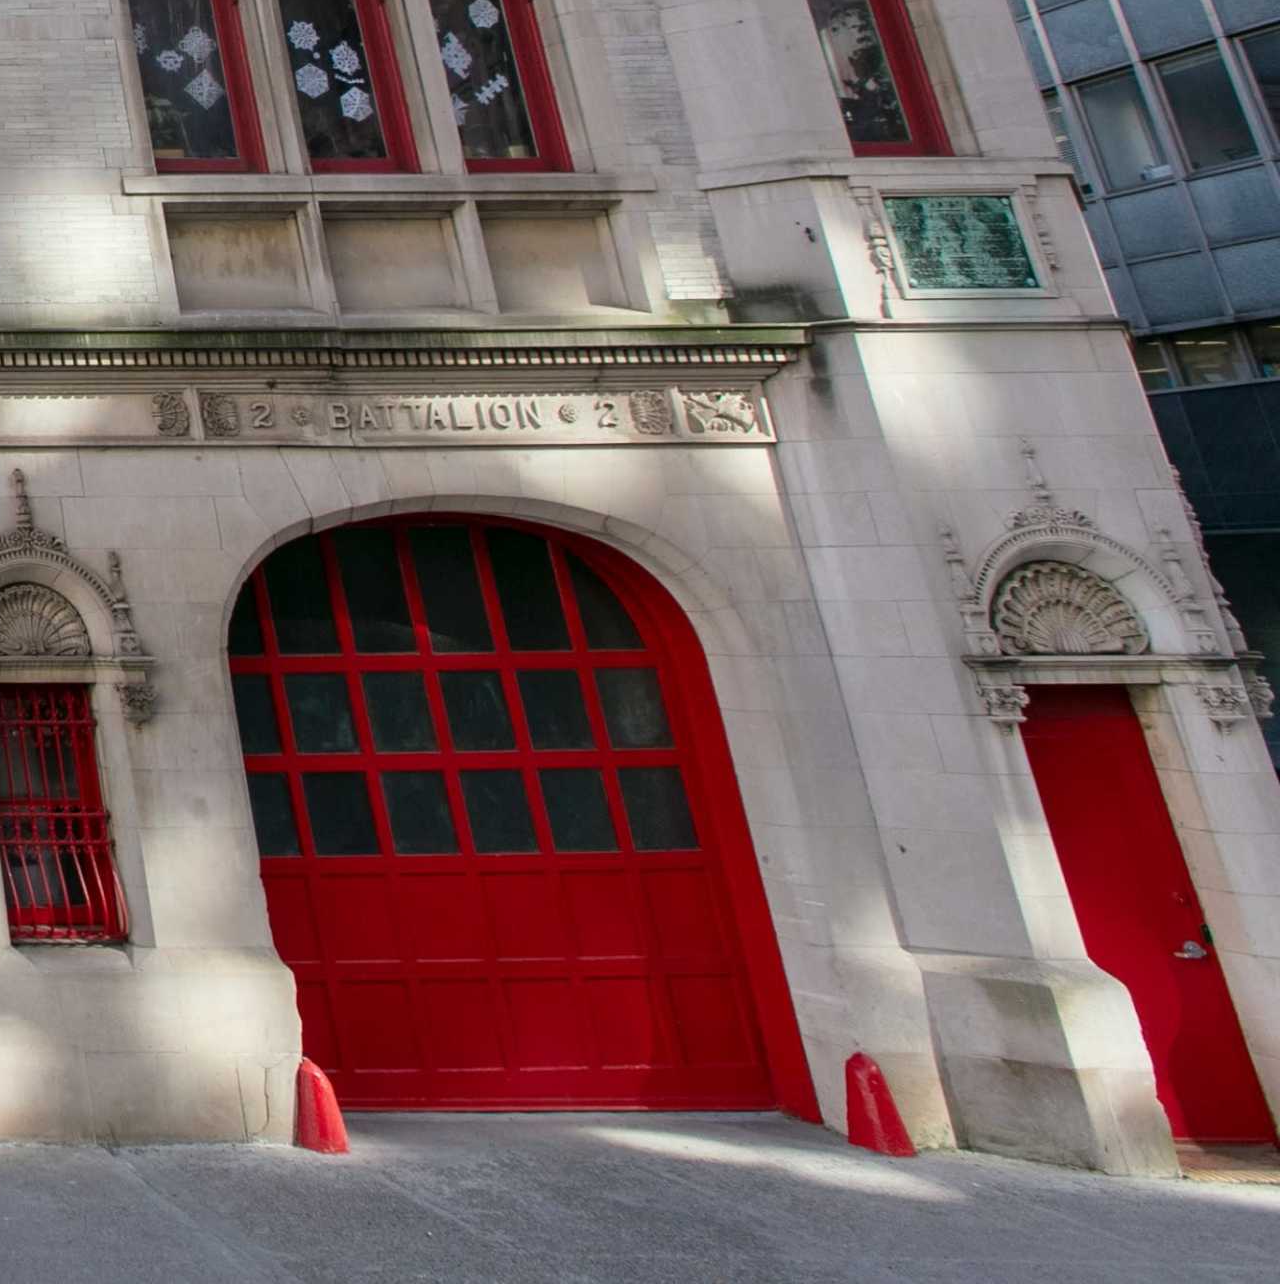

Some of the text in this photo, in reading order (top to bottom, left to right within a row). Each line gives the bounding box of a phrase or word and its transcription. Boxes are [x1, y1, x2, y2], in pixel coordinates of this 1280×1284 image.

[250, 401, 620, 431] 2 BATTALION 2
